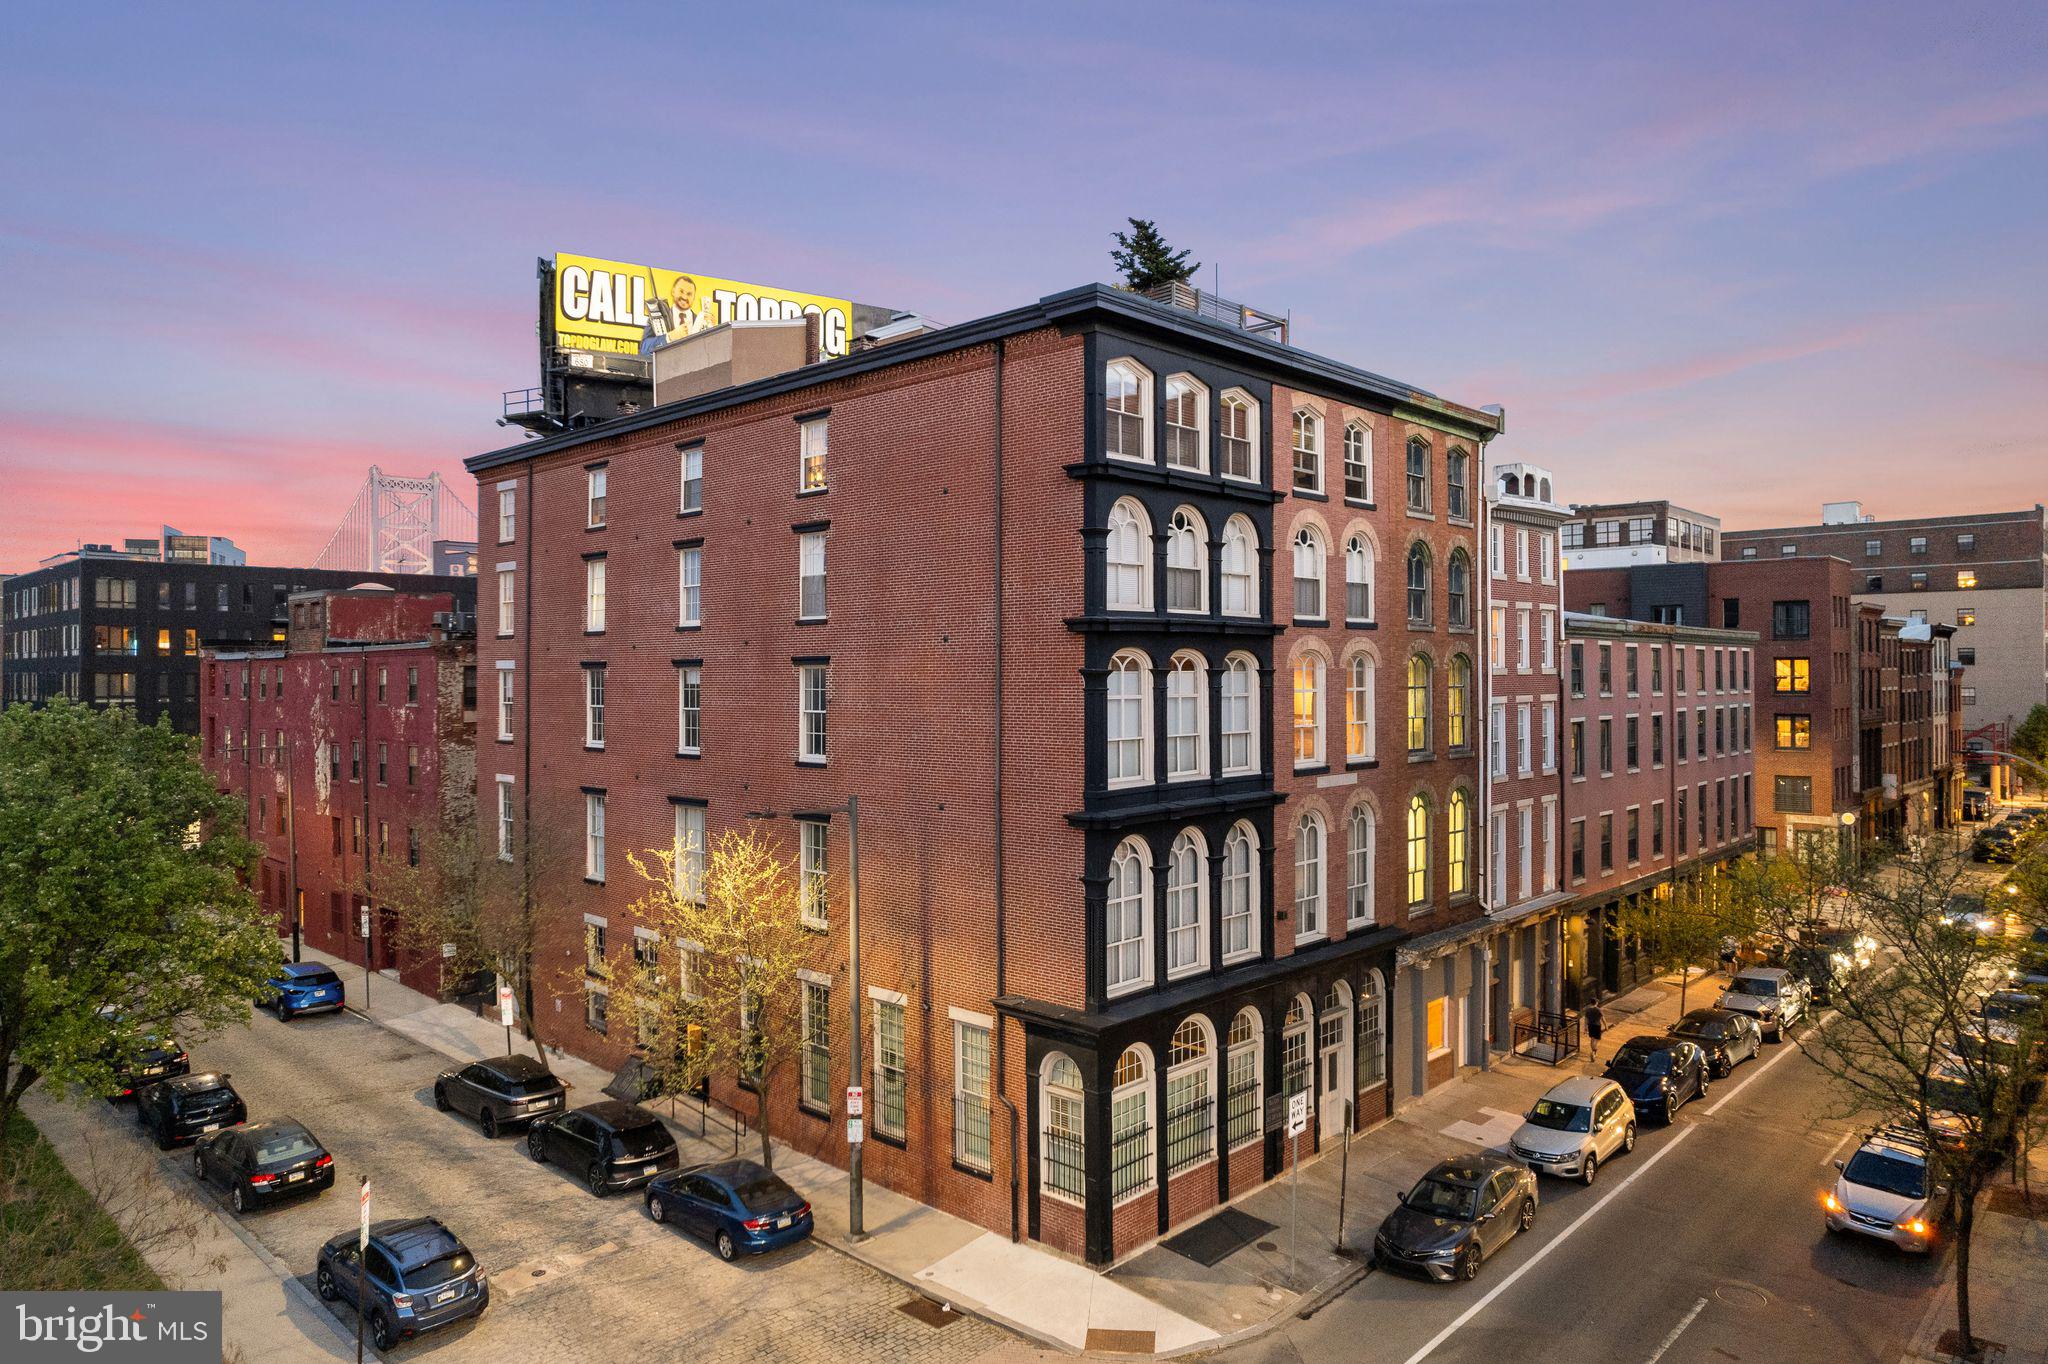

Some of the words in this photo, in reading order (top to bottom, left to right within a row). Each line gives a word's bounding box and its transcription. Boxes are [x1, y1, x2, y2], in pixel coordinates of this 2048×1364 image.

[561, 265, 649, 328] CALL
[558, 333, 639, 355] TOPDOGLAW.COM
[1291, 1096, 1304, 1109] ONE
[1291, 1106, 1304, 1119] WAY
